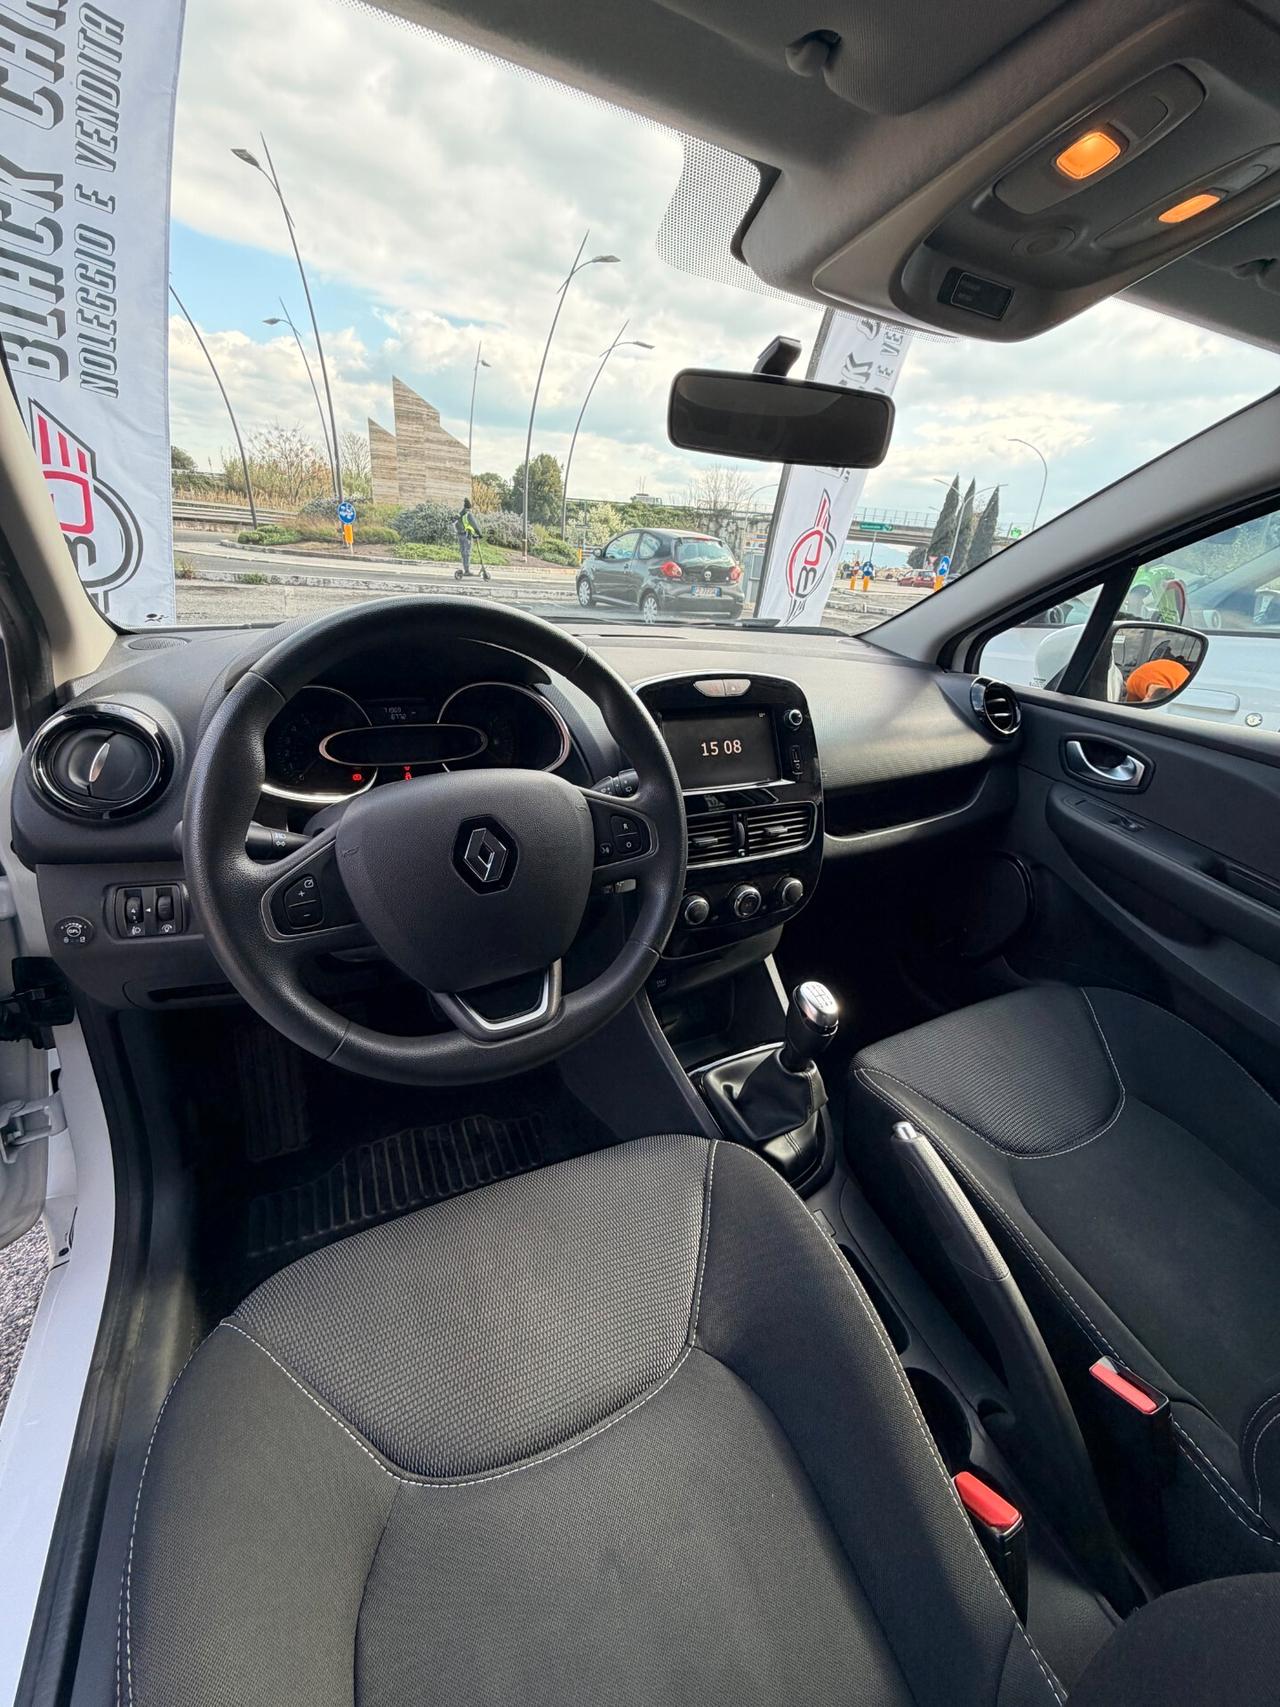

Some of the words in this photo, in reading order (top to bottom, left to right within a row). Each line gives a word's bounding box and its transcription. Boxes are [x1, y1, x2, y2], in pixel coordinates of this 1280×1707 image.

[75, 2, 124, 172] VENDITA
[0, 155, 68, 382] BLACK
[74, 184, 115, 214] E
[74, 223, 119, 399] NOLEGGIO
[701, 741, 719, 756] 15
[723, 739, 742, 754] 08
